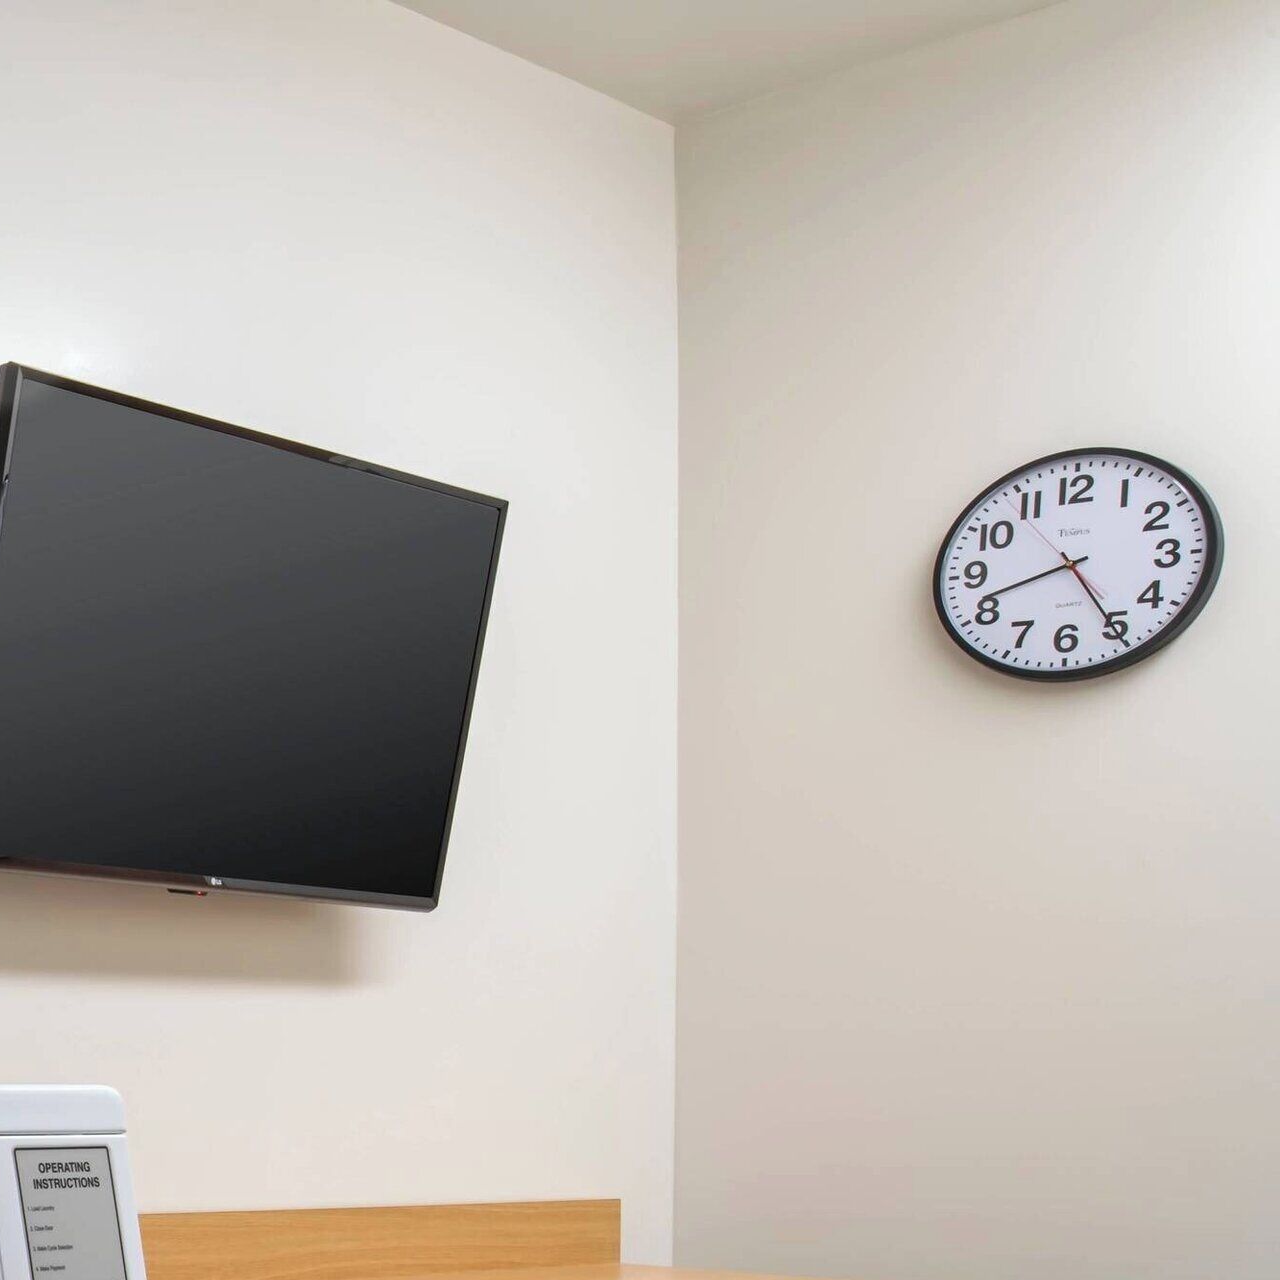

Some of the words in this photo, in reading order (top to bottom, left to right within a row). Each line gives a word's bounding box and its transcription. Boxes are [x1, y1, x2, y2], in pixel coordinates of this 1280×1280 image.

[1058, 474, 1094, 505] 12
[1120, 479, 1129, 507] 1
[1020, 491, 1041, 520] 11
[1143, 501, 1170, 532] 2
[979, 521, 1014, 551] 10
[1154, 539, 1181, 568] 3
[964, 561, 988, 589] 9
[1137, 580, 1163, 608] 4
[975, 597, 999, 625] 8
[1101, 610, 1128, 640] 5
[1011, 620, 1034, 648] 7
[1053, 625, 1078, 653] 6
[38, 1162, 91, 1174] OPERATING
[33, 1177, 100, 1189] INSTRUCTIONS
